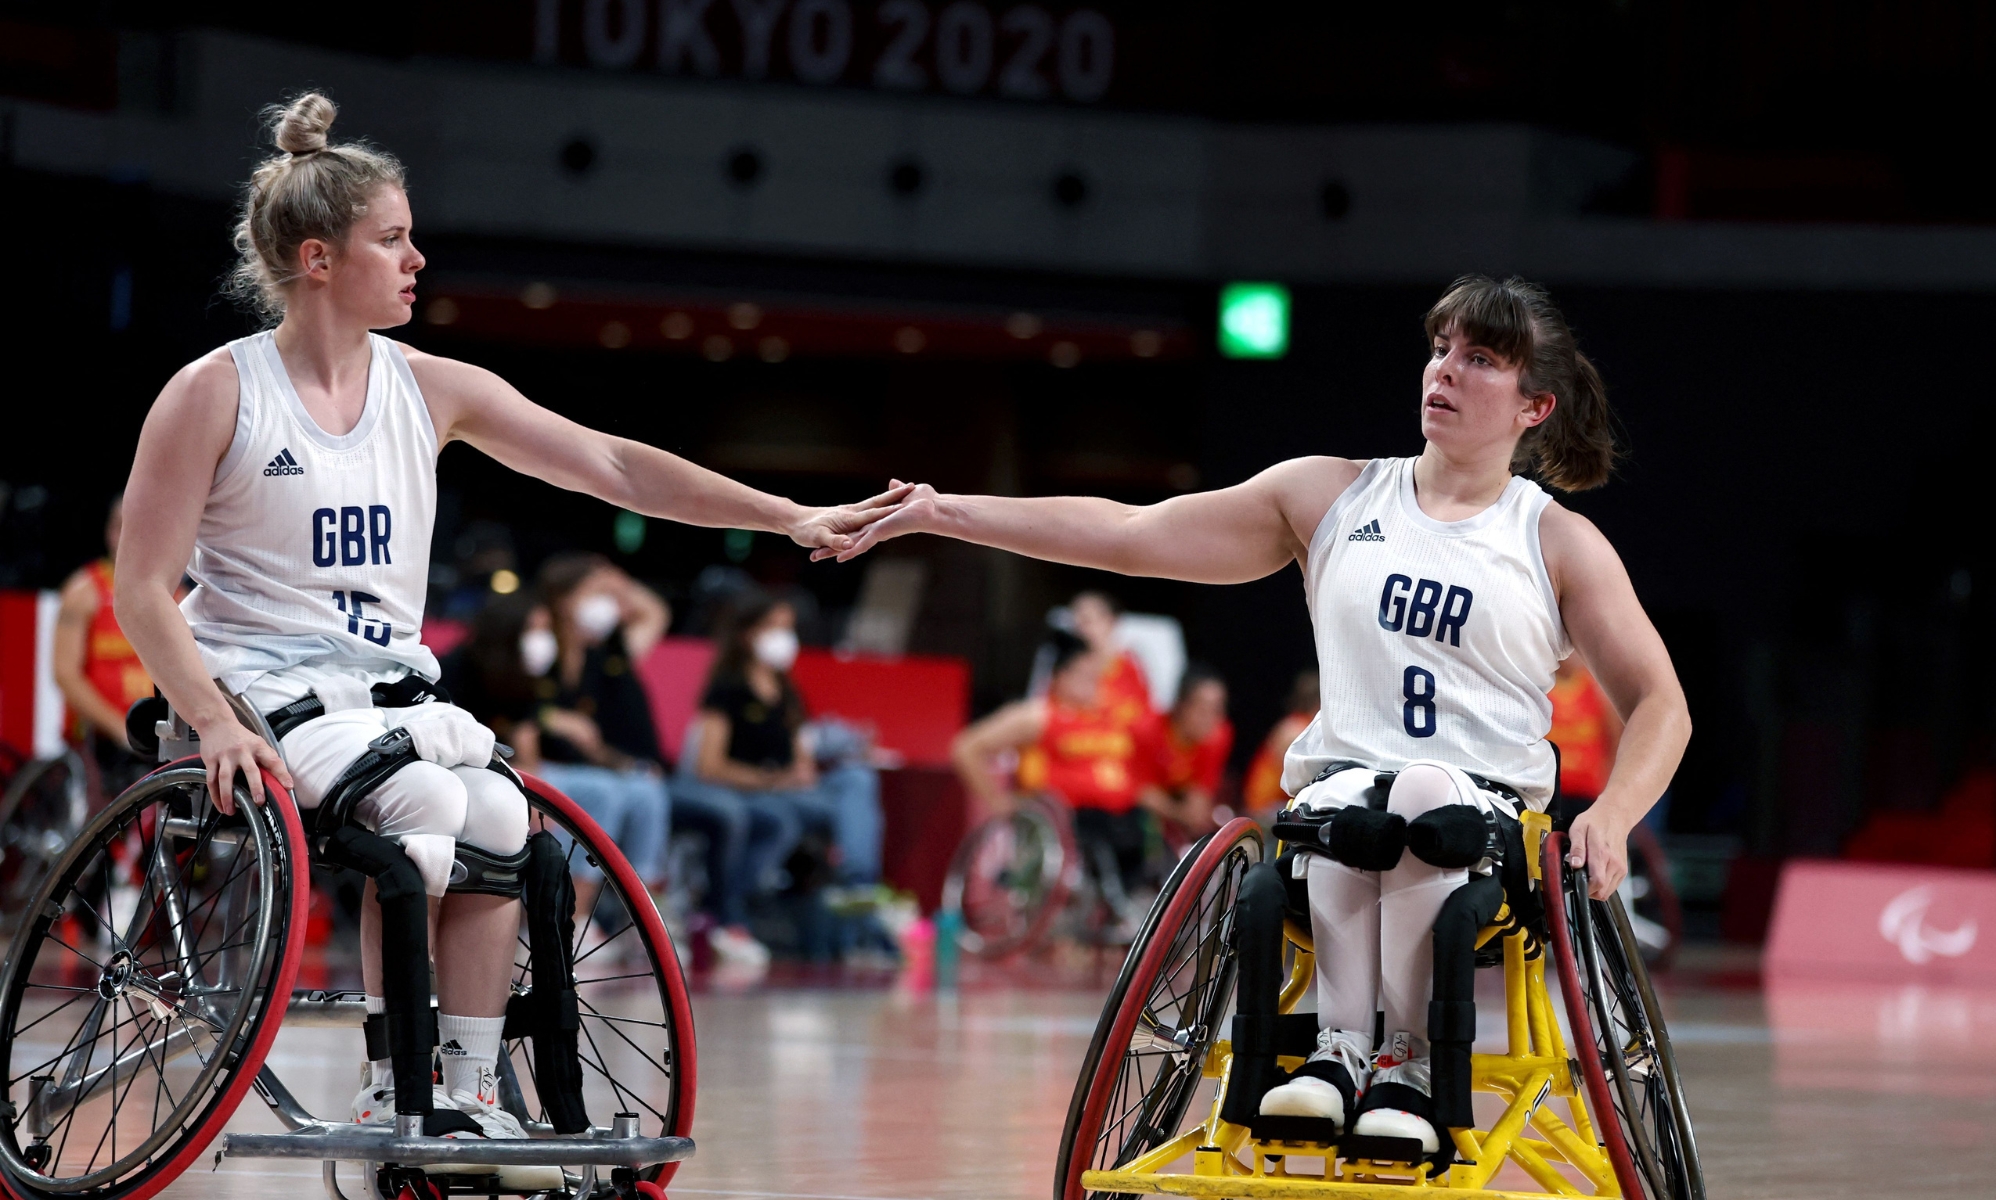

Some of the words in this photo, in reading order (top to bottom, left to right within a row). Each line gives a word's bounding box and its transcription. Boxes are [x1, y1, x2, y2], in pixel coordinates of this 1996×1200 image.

[531, 0, 857, 86] TOKYO
[872, 0, 1117, 102] 2020
[263, 465, 304, 477] adidas
[312, 504, 392, 568] GBR
[1348, 532, 1386, 543] adidas
[331, 590, 392, 648] 15
[1378, 573, 1474, 648] GBR
[1403, 665, 1437, 738] 8
